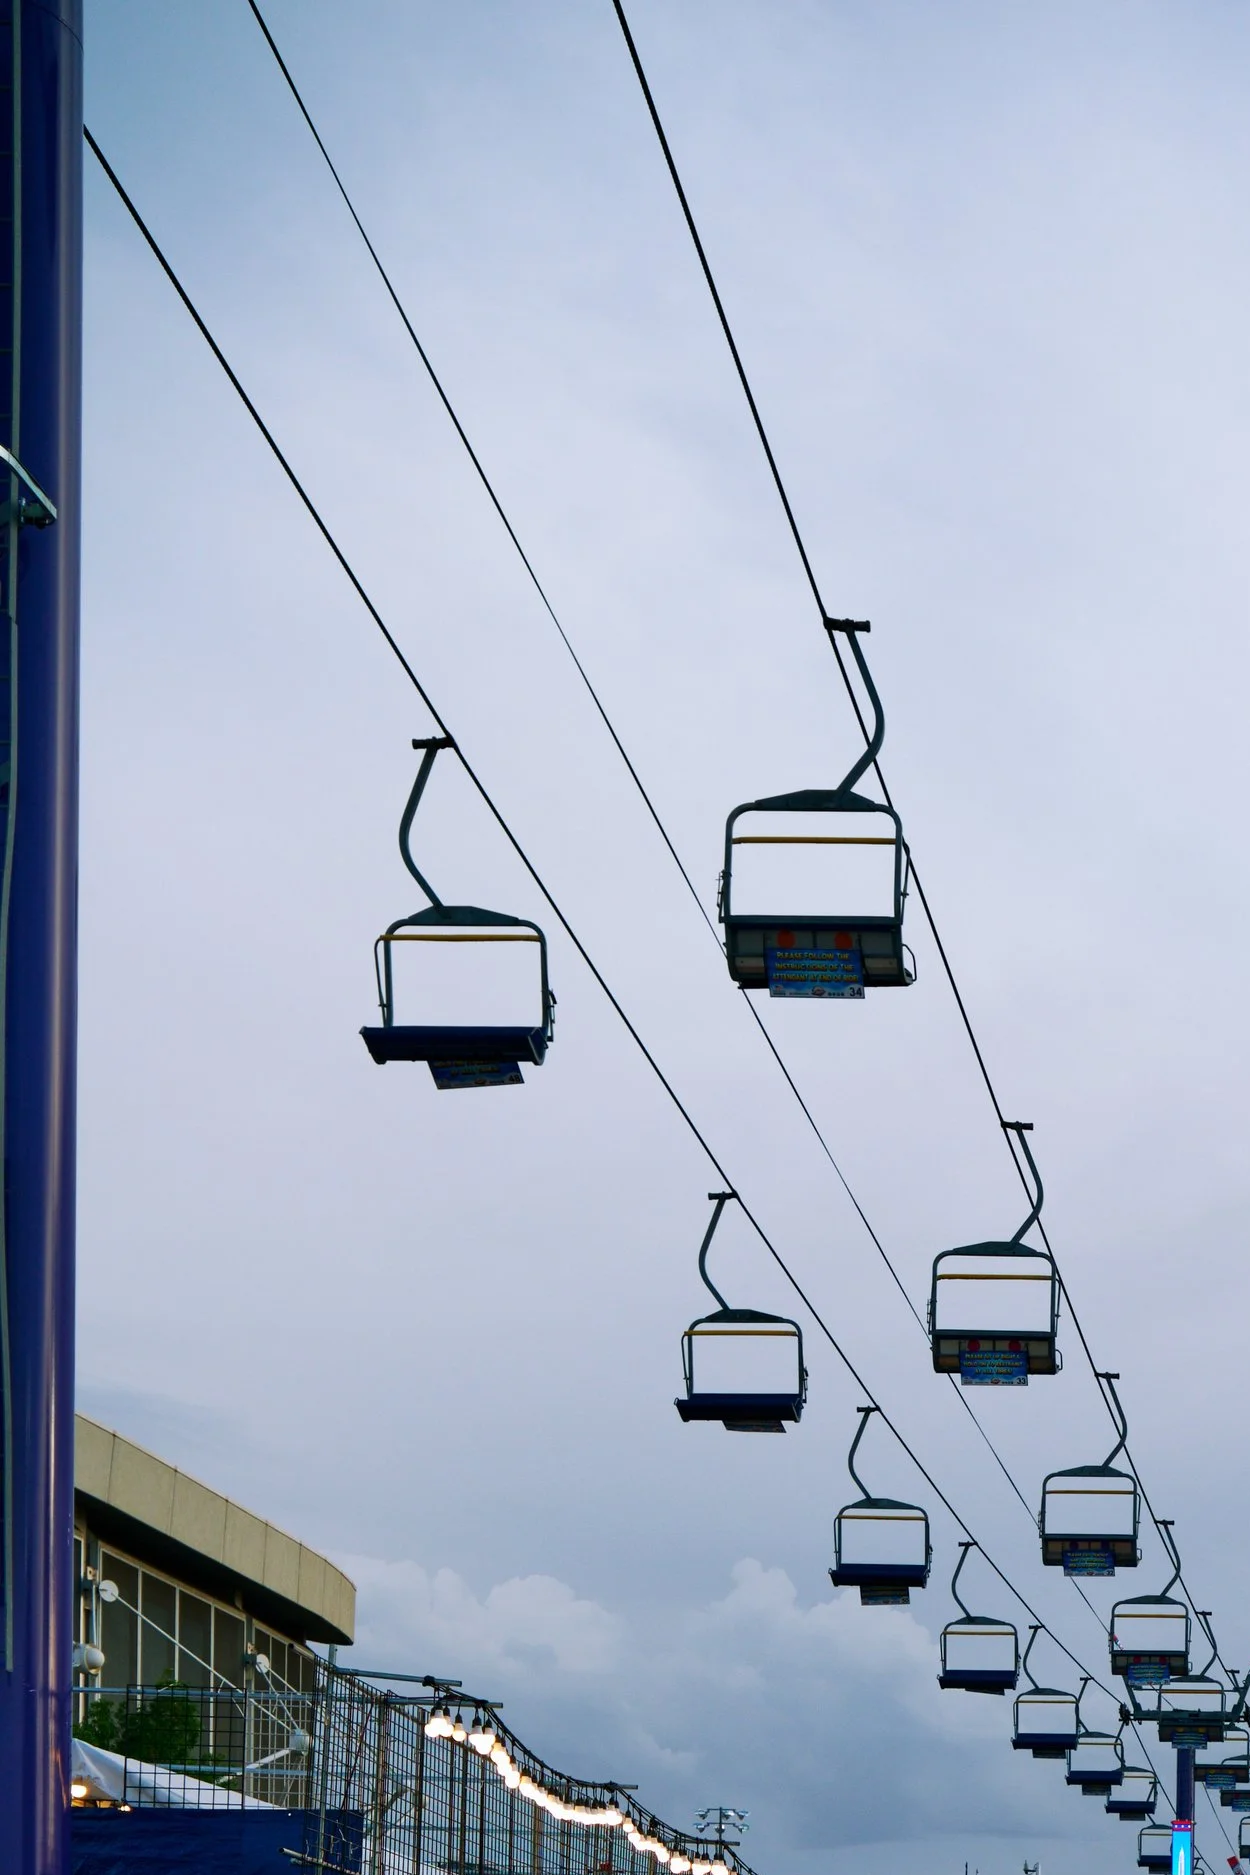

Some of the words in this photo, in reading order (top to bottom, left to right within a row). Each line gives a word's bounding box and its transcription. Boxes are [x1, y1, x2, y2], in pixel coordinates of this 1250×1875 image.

[777, 952, 803, 960] PLEASE
[805, 952, 834, 960] FOLLOW
[849, 986, 862, 997] 34
[1017, 1377, 1026, 1385] 33
